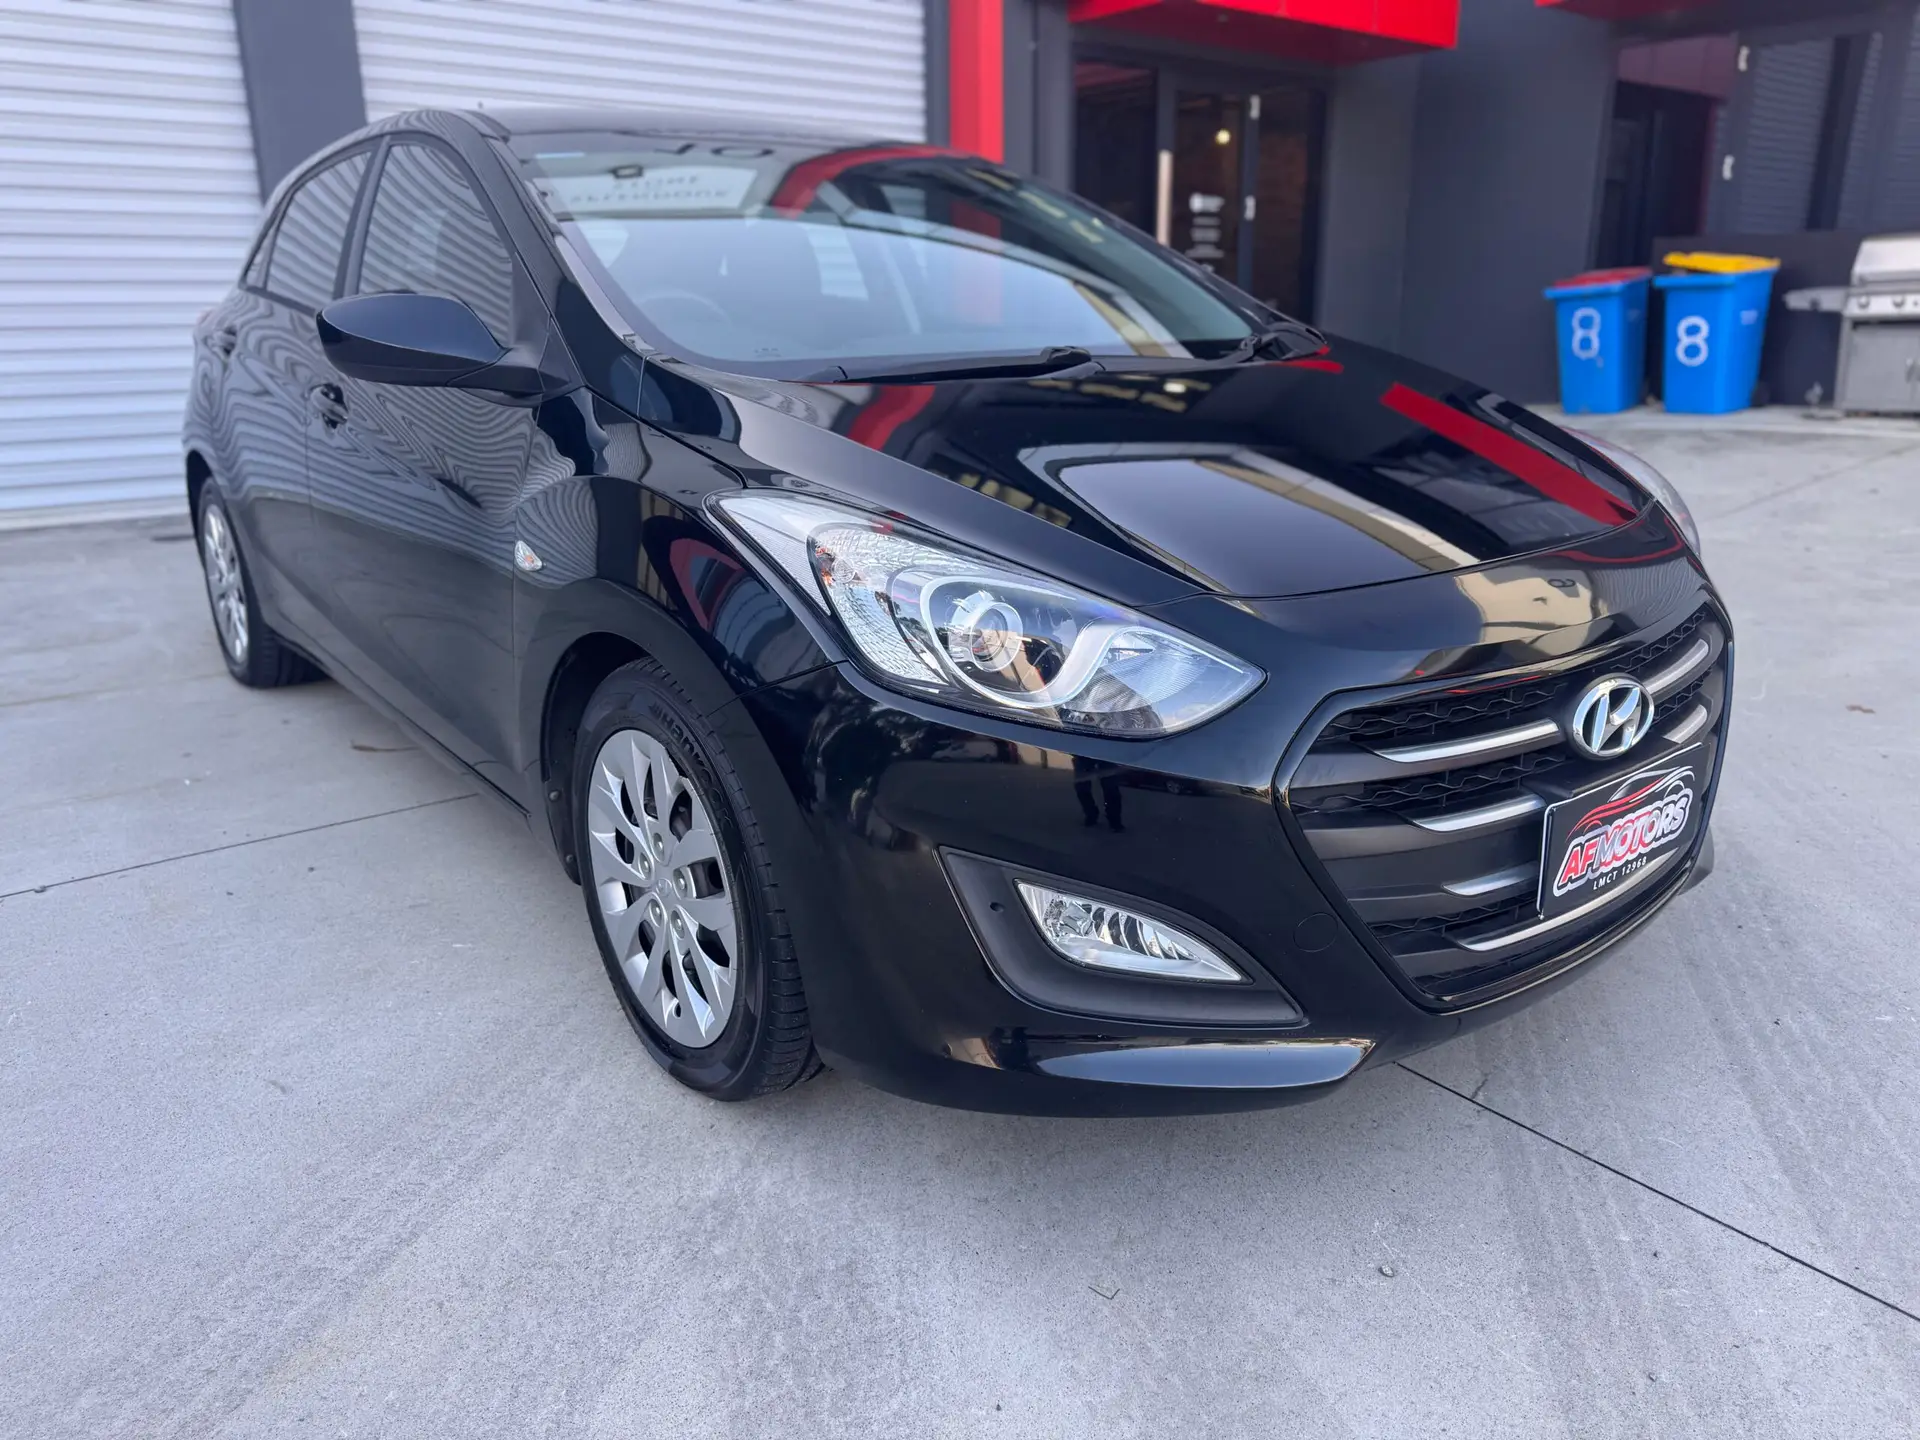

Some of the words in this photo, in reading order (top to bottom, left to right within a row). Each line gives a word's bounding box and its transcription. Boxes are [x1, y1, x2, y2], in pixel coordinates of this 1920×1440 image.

[1571, 307, 1602, 361] 8
[1675, 315, 1710, 367] 8
[1592, 871, 1619, 890] LMCT
[1621, 856, 1648, 876] 12968
